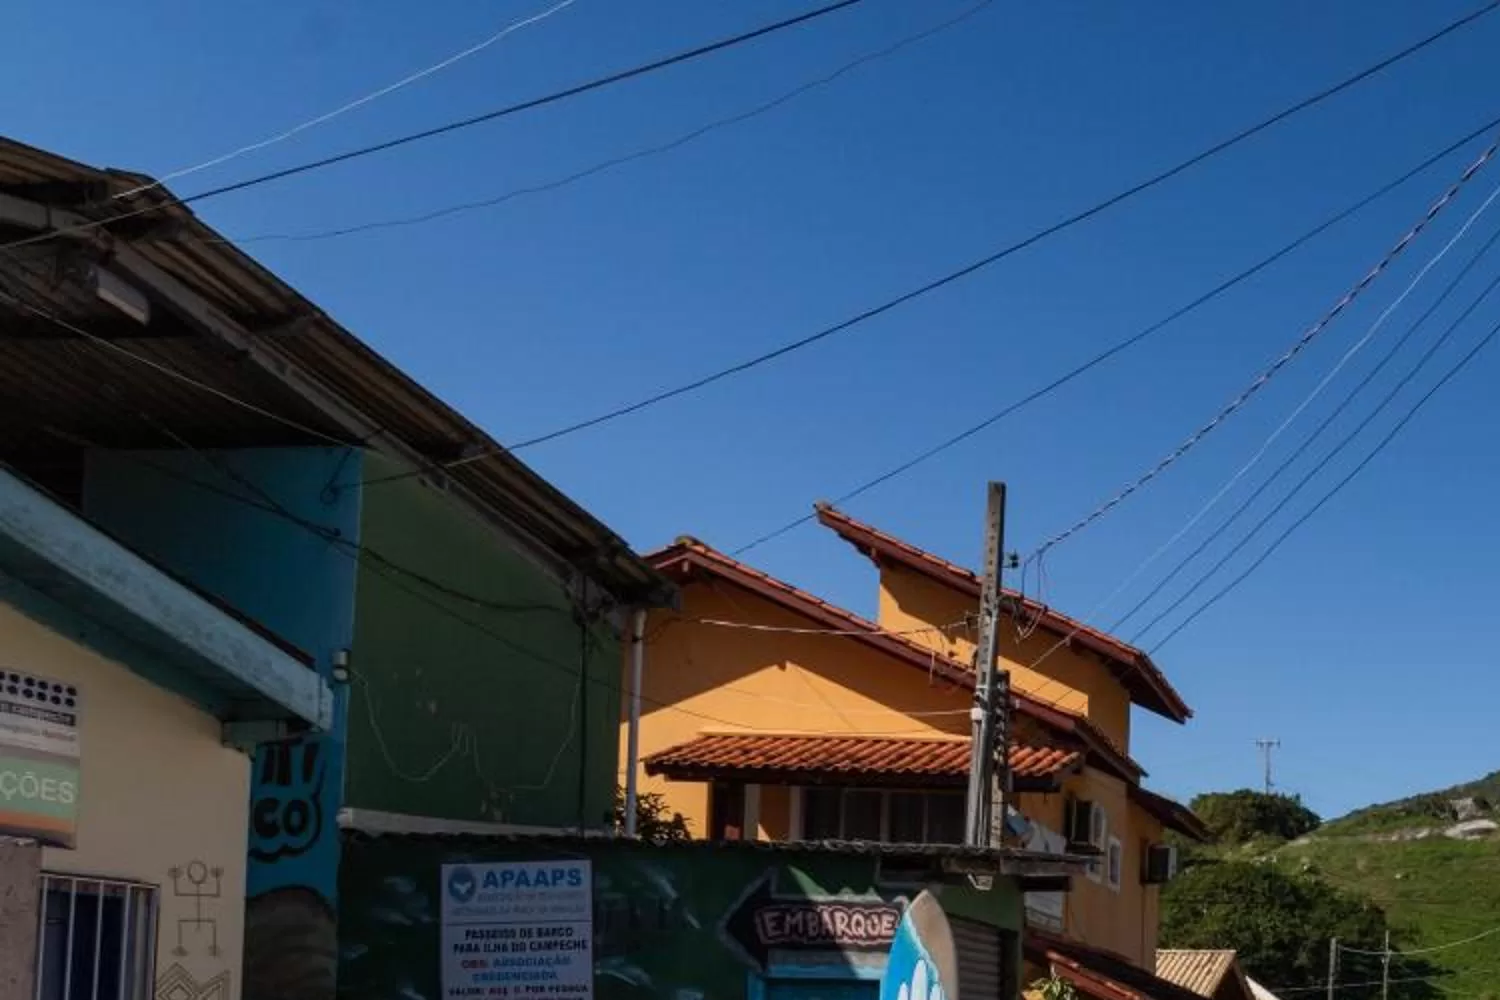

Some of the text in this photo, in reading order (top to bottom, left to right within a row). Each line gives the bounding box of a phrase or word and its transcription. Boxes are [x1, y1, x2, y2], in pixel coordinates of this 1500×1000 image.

[483, 867, 582, 889] APAAPS
[519, 928, 534, 939] DE
[537, 926, 573, 938] BARCO
[763, 909, 896, 939] EMBARQUE
[453, 939, 588, 955] PARA ILHA DO CAMPECHE
